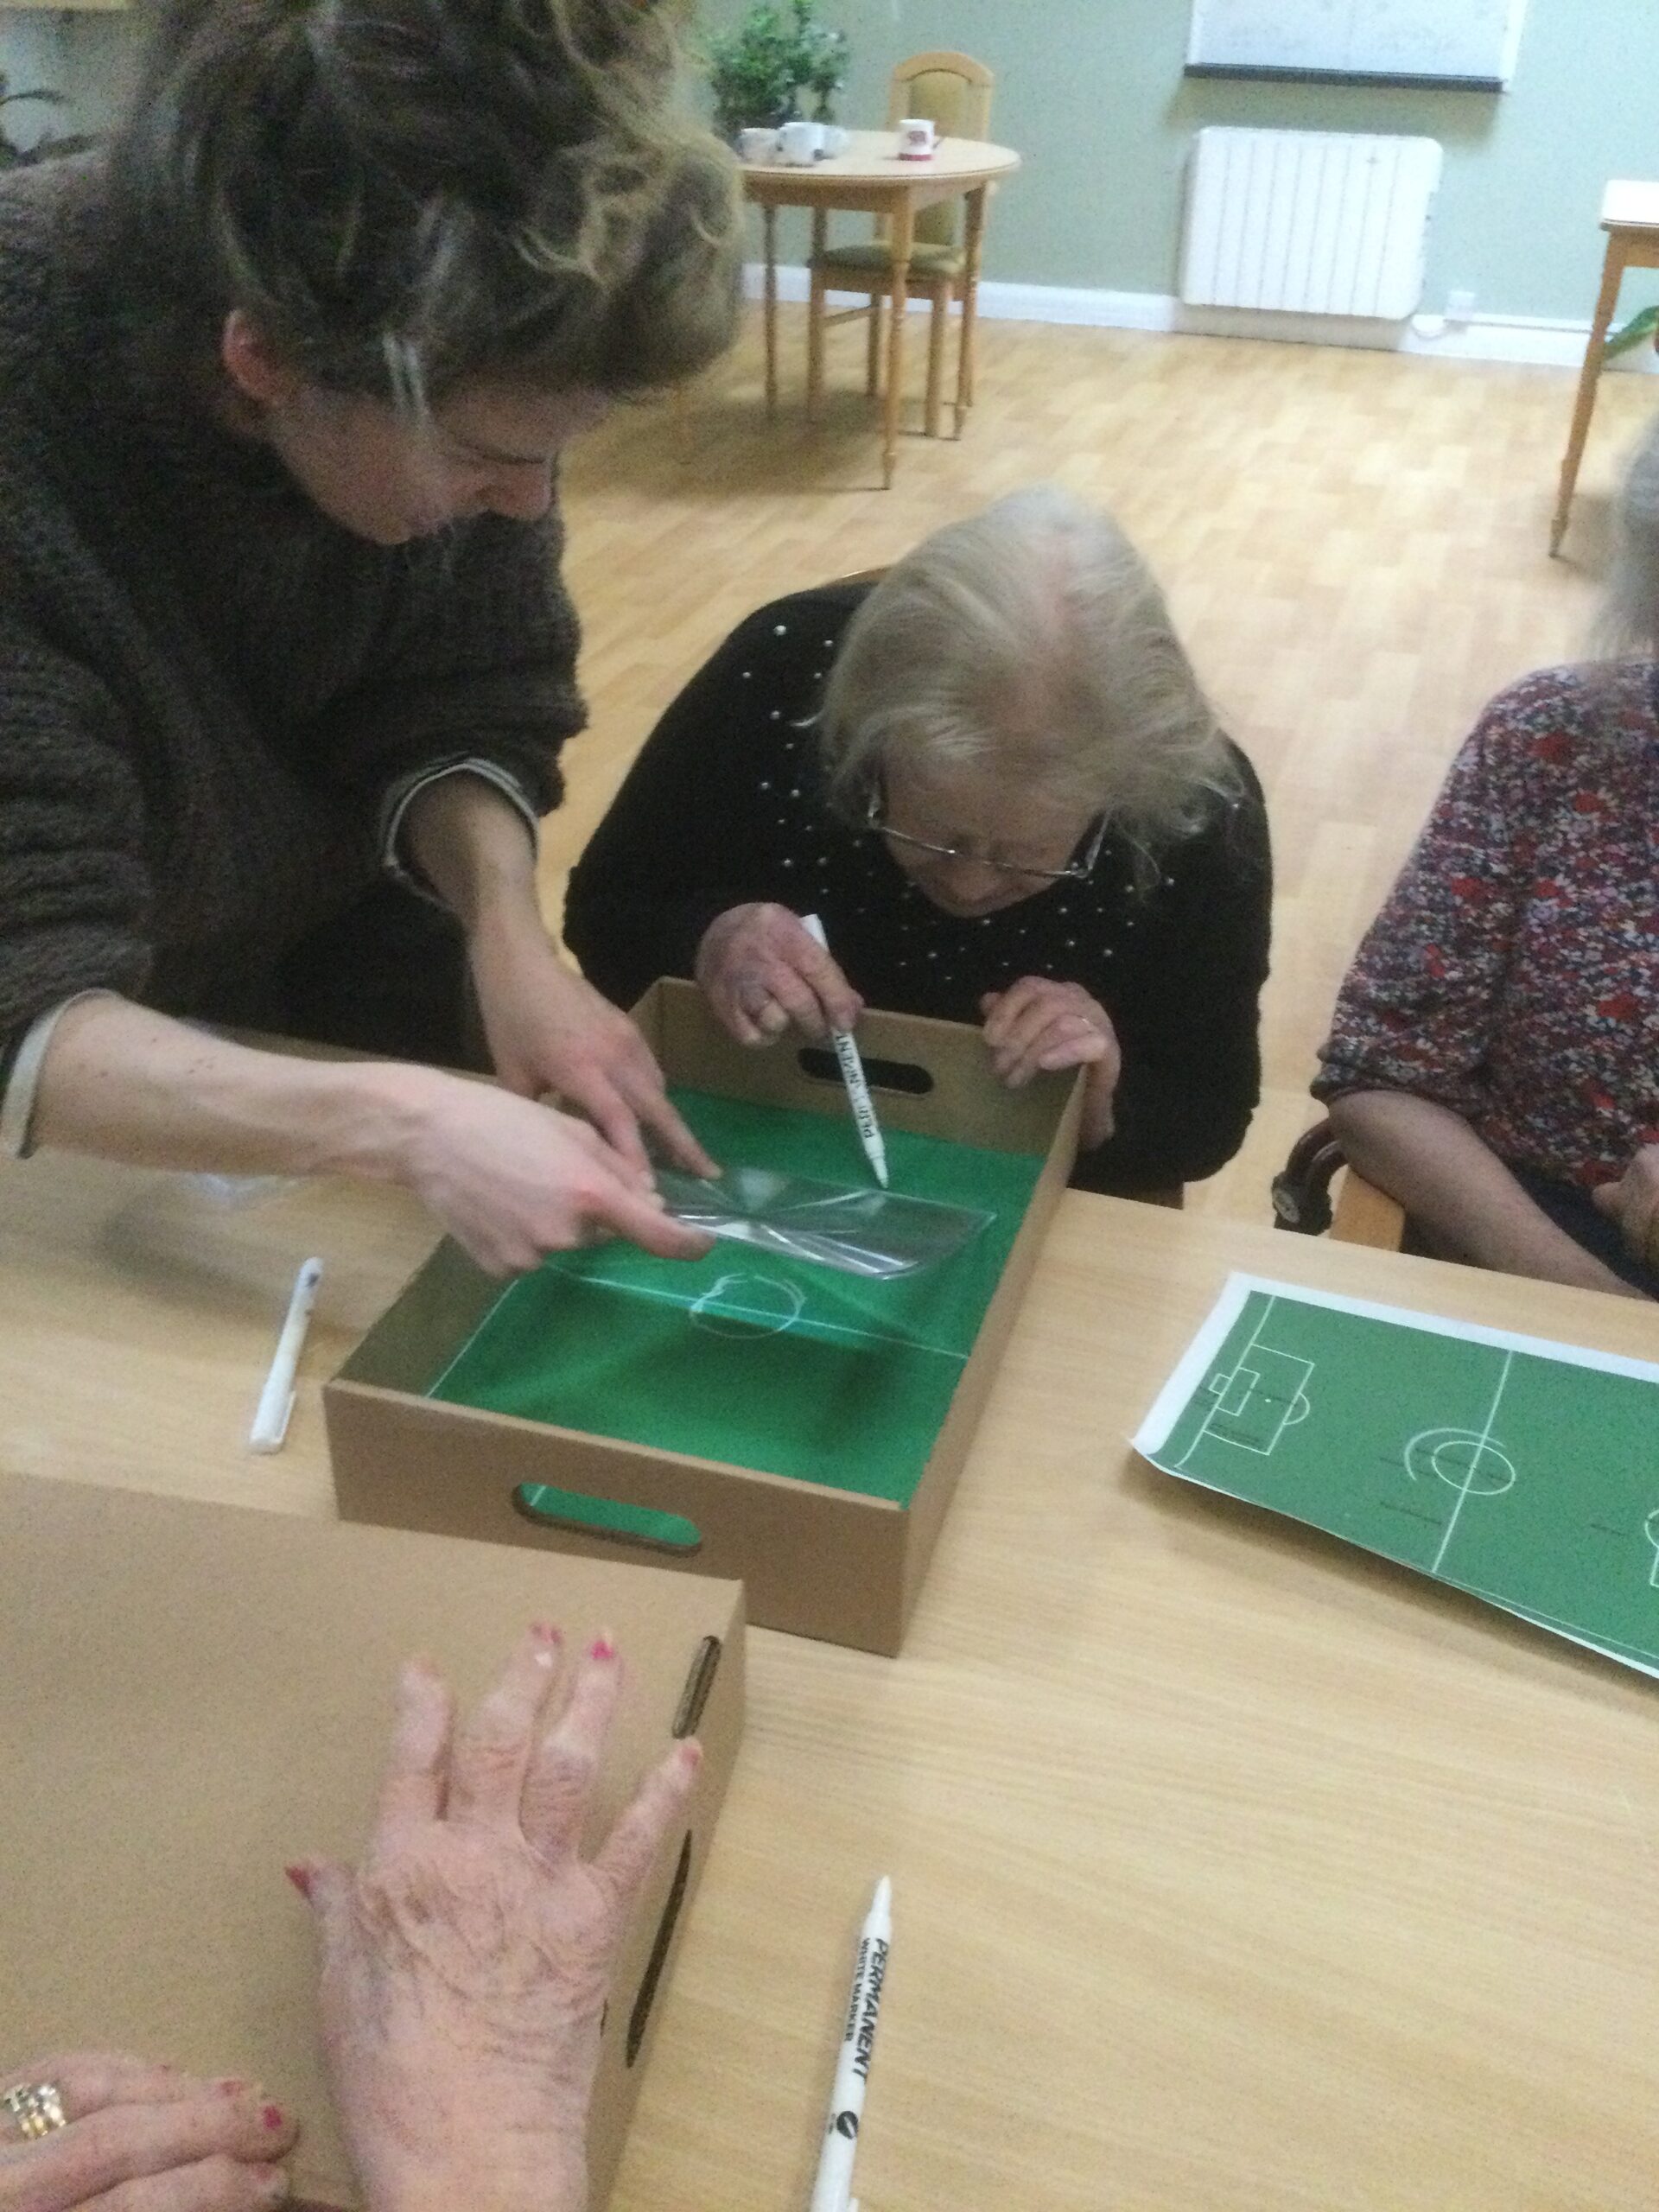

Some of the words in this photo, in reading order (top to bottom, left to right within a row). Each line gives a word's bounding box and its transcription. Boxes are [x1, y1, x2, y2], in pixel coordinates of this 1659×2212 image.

[855, 1937, 870, 1980] WHITE
[843, 1982, 862, 2042] MARKER
[852, 1938, 888, 2083] PERMANENT
